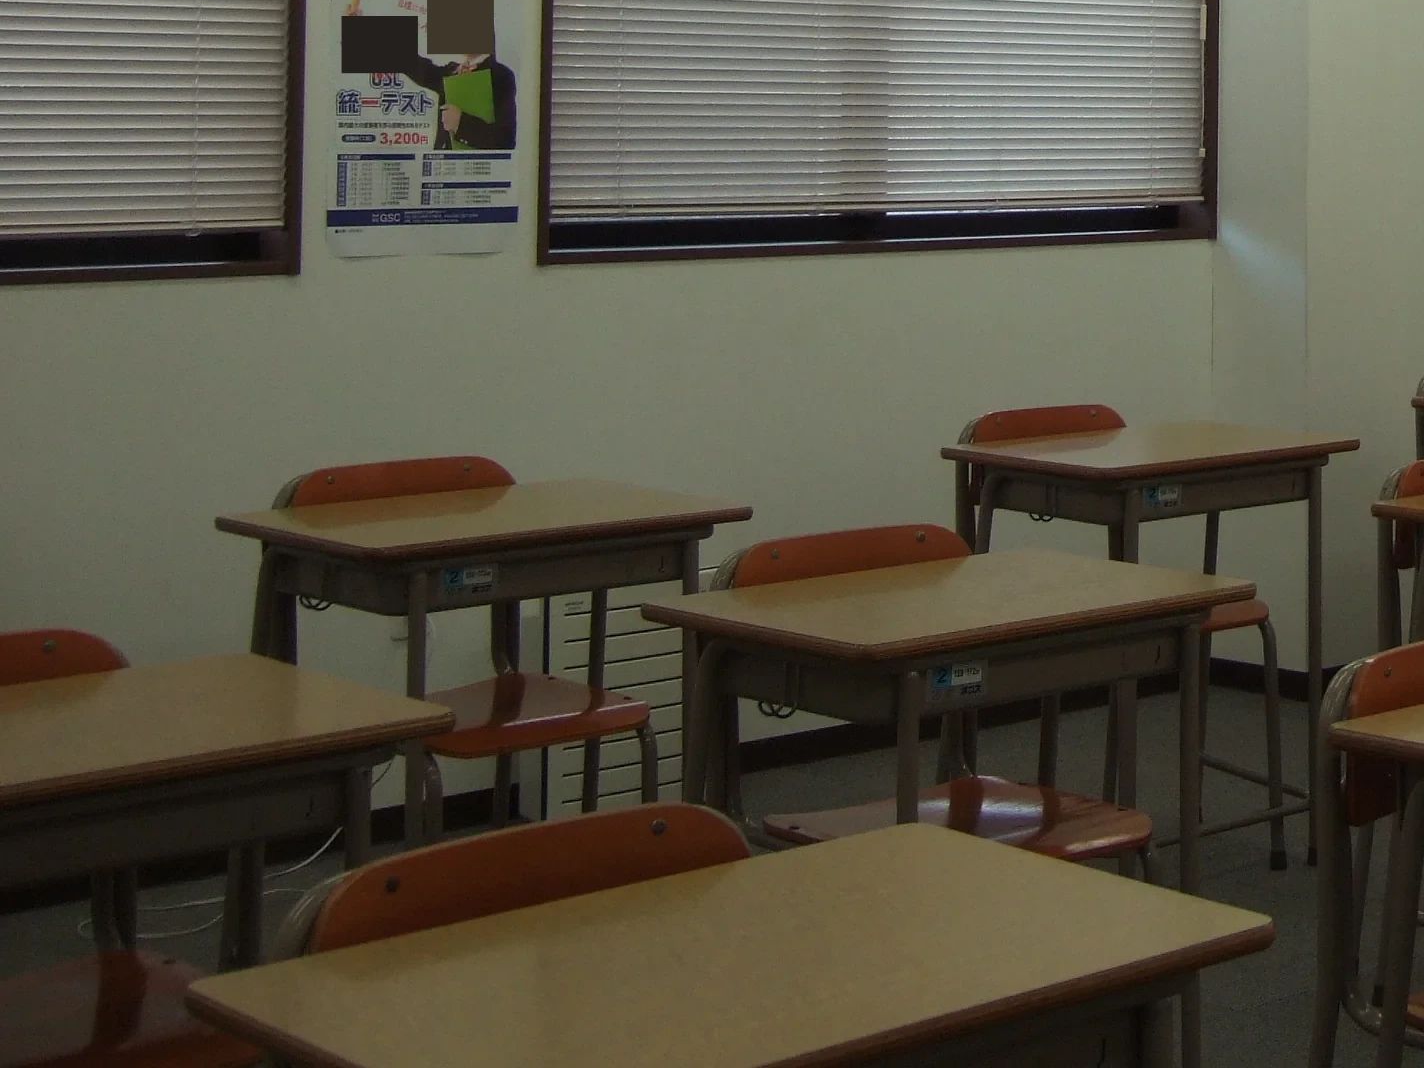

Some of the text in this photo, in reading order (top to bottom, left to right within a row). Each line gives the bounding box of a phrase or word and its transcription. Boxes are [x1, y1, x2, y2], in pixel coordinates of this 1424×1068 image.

[337, 90, 434, 116] 統一テスト
